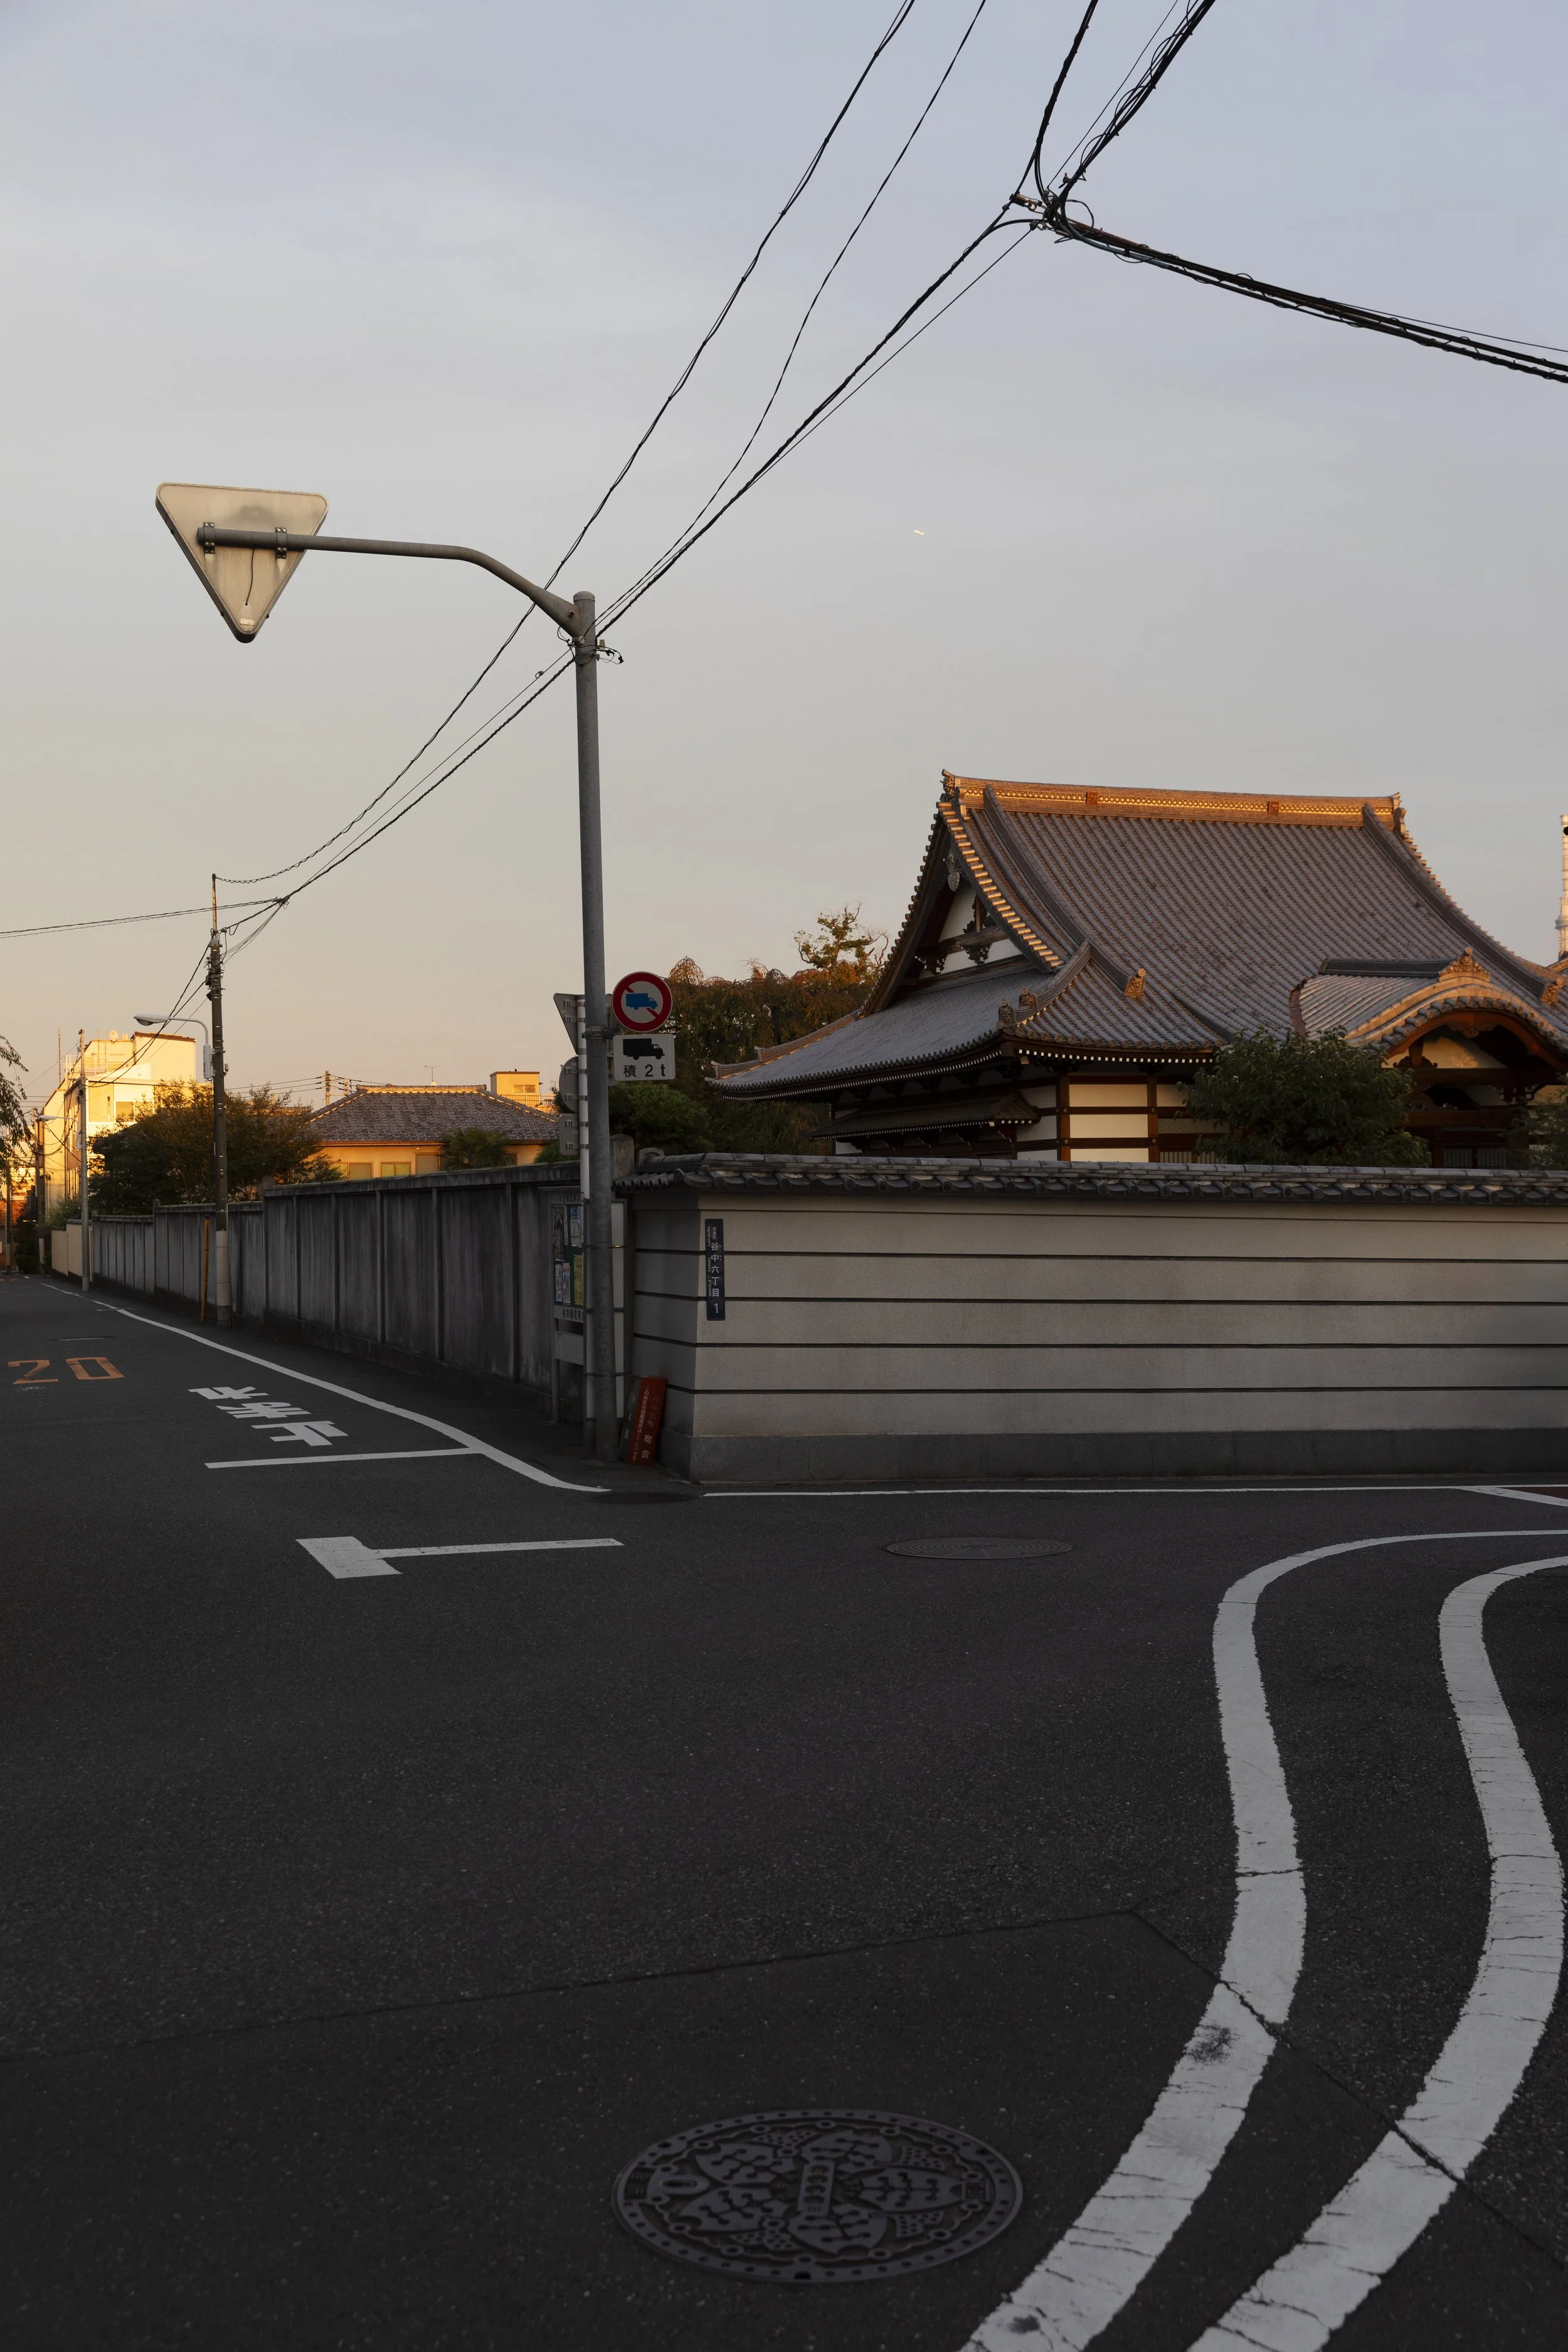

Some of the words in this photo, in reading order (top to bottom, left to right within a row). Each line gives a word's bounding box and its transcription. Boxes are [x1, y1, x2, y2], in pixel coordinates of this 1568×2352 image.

[711, 1242, 719, 1297] 谷中六丁目
[713, 1303, 718, 1314] 1
[7, 1356, 125, 1385] 20
